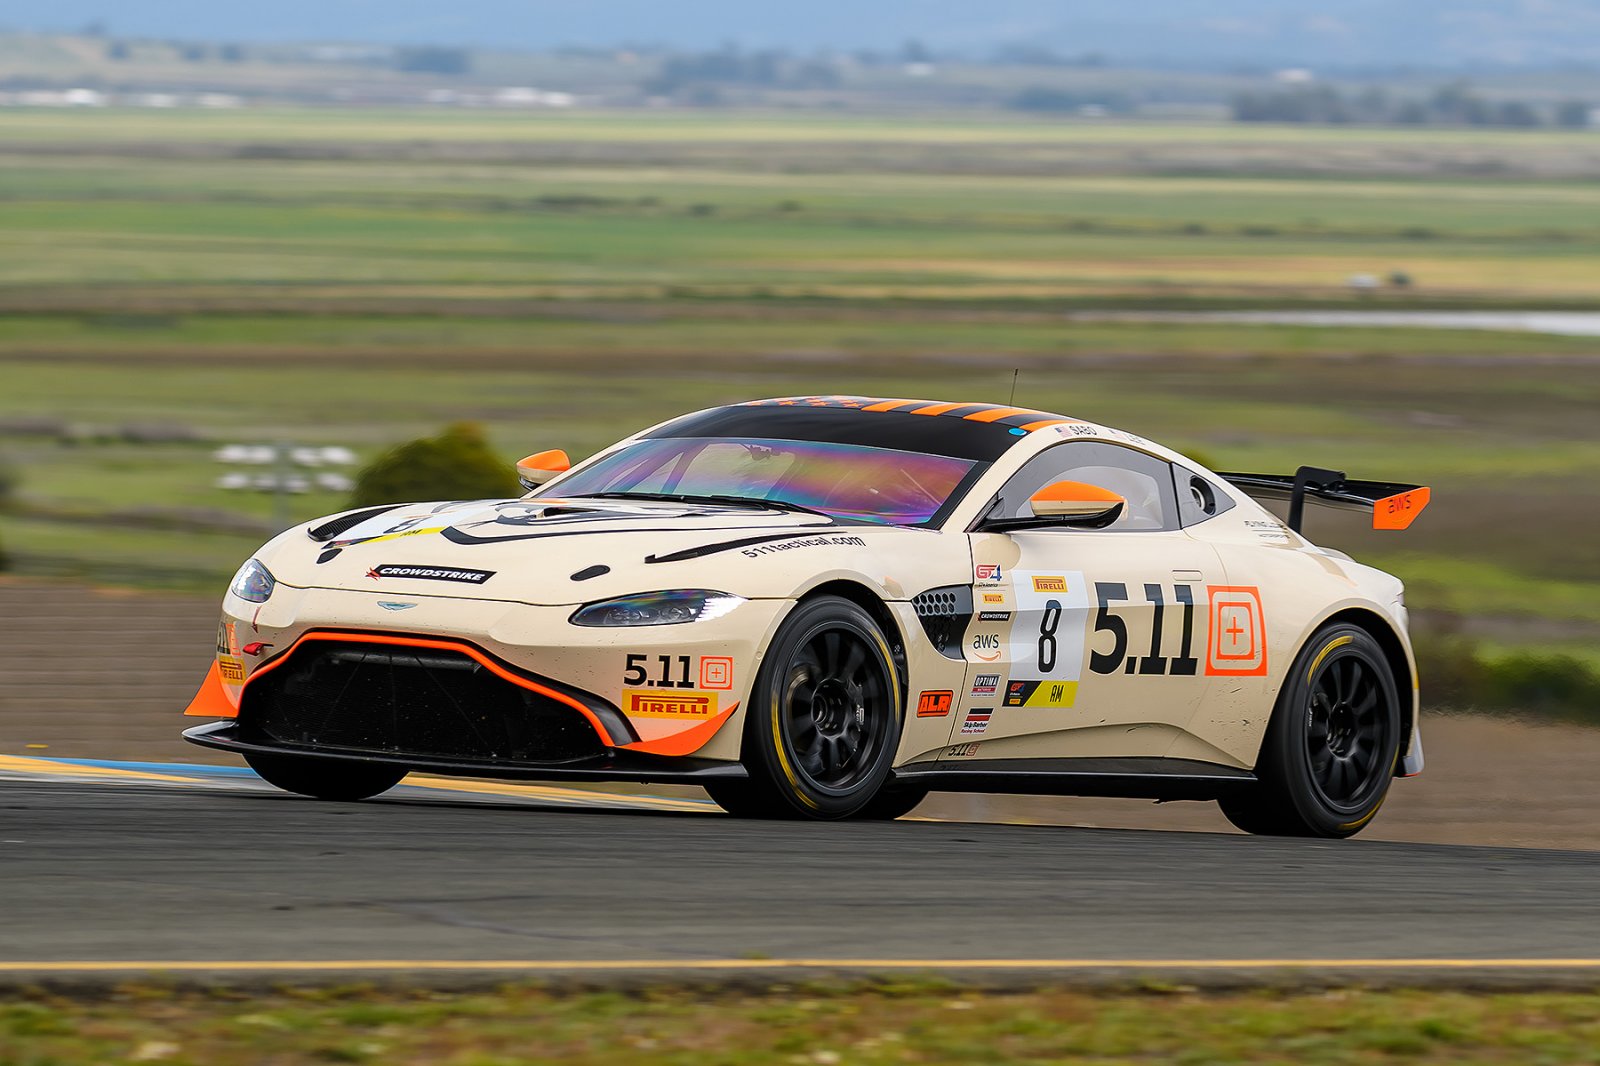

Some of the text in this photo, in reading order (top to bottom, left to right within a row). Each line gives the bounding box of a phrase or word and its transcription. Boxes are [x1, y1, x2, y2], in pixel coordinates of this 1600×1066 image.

[1069, 425, 1098, 436] SABO
[741, 536, 867, 558] 511tactical.com
[380, 567, 486, 581] CROWDSTRIKE
[976, 564, 1003, 581] GT4
[1035, 578, 1065, 590] PIRELLI
[1038, 599, 1063, 673] 8
[1089, 582, 1198, 675] 5.11
[973, 633, 1000, 650] aws
[623, 653, 695, 689] 5.11
[975, 676, 999, 687] OPTIMA
[1049, 684, 1065, 703] AM
[631, 694, 710, 714] PIRELLI
[920, 694, 951, 712] ALR
[947, 743, 970, 757] 5.11
